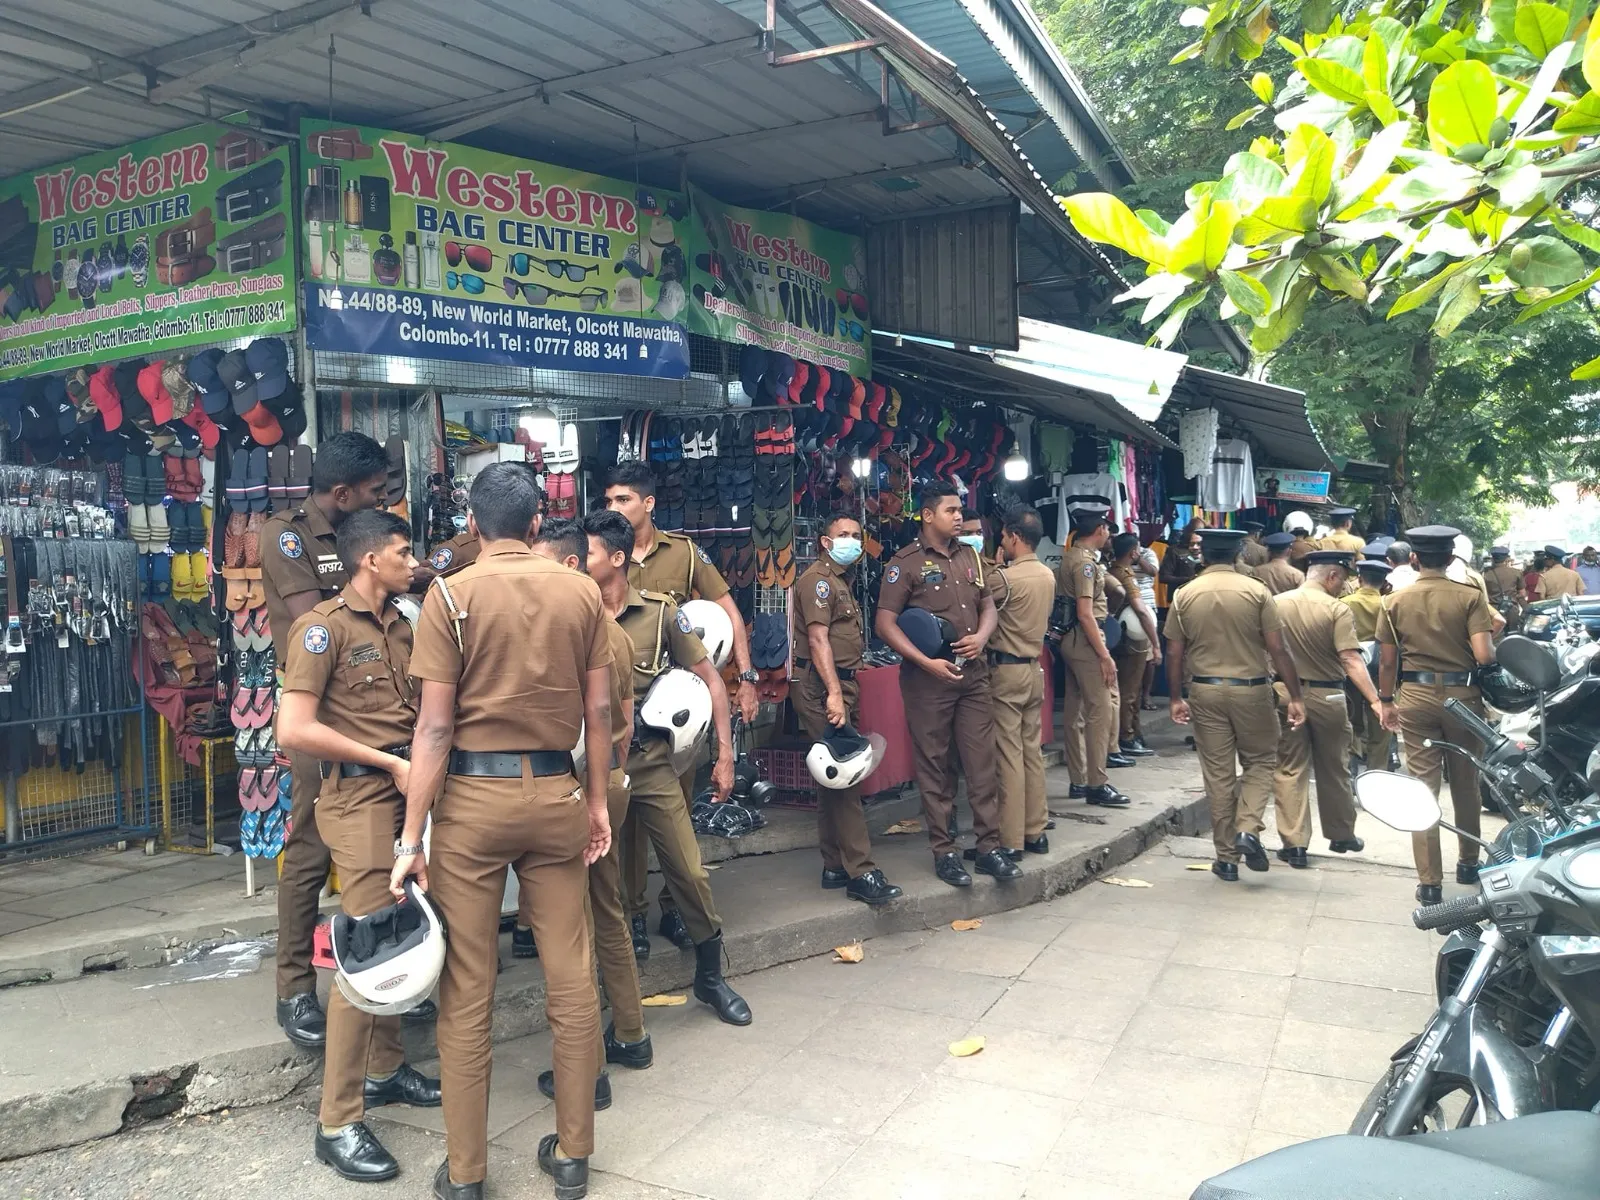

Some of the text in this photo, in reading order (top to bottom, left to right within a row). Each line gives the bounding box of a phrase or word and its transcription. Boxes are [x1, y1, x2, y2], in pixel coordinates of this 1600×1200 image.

[35, 143, 209, 224] Western
[378, 138, 638, 236] Western
[53, 194, 191, 249] BAG CENTER
[416, 204, 612, 260] BAG CENTER
[723, 213, 832, 284] Western
[736, 252, 823, 295] BAG CENTER
[54, 308, 86, 331] Imported
[86, 304, 100, 322] and
[101, 300, 120, 319] Local
[145, 292, 178, 312] Slippers,
[179, 284, 212, 305] Leather
[211, 281, 240, 298] Purse,
[240, 274, 284, 295] Sunglass
[318, 288, 683, 346] N.44/88-89, New World Market, Olcott Mawatha,
[704, 291, 741, 319] Dealers
[29, 344, 46, 363] New
[45, 338, 66, 360] World
[65, 333, 93, 356] Market,
[94, 328, 118, 351] Olcott
[117, 323, 153, 345] Mawatha,
[153, 314, 203, 340] Colombo-11.
[204, 310, 218, 331] Tel
[224, 305, 248, 328] 0777
[248, 302, 266, 325] 888
[267, 300, 286, 322] 341
[399, 322, 496, 349] Colombo-11.
[498, 333, 521, 352] Tel
[534, 337, 570, 356] 0777
[573, 340, 600, 358] 888
[603, 343, 628, 360] 341
[317, 561, 344, 574] 97972
